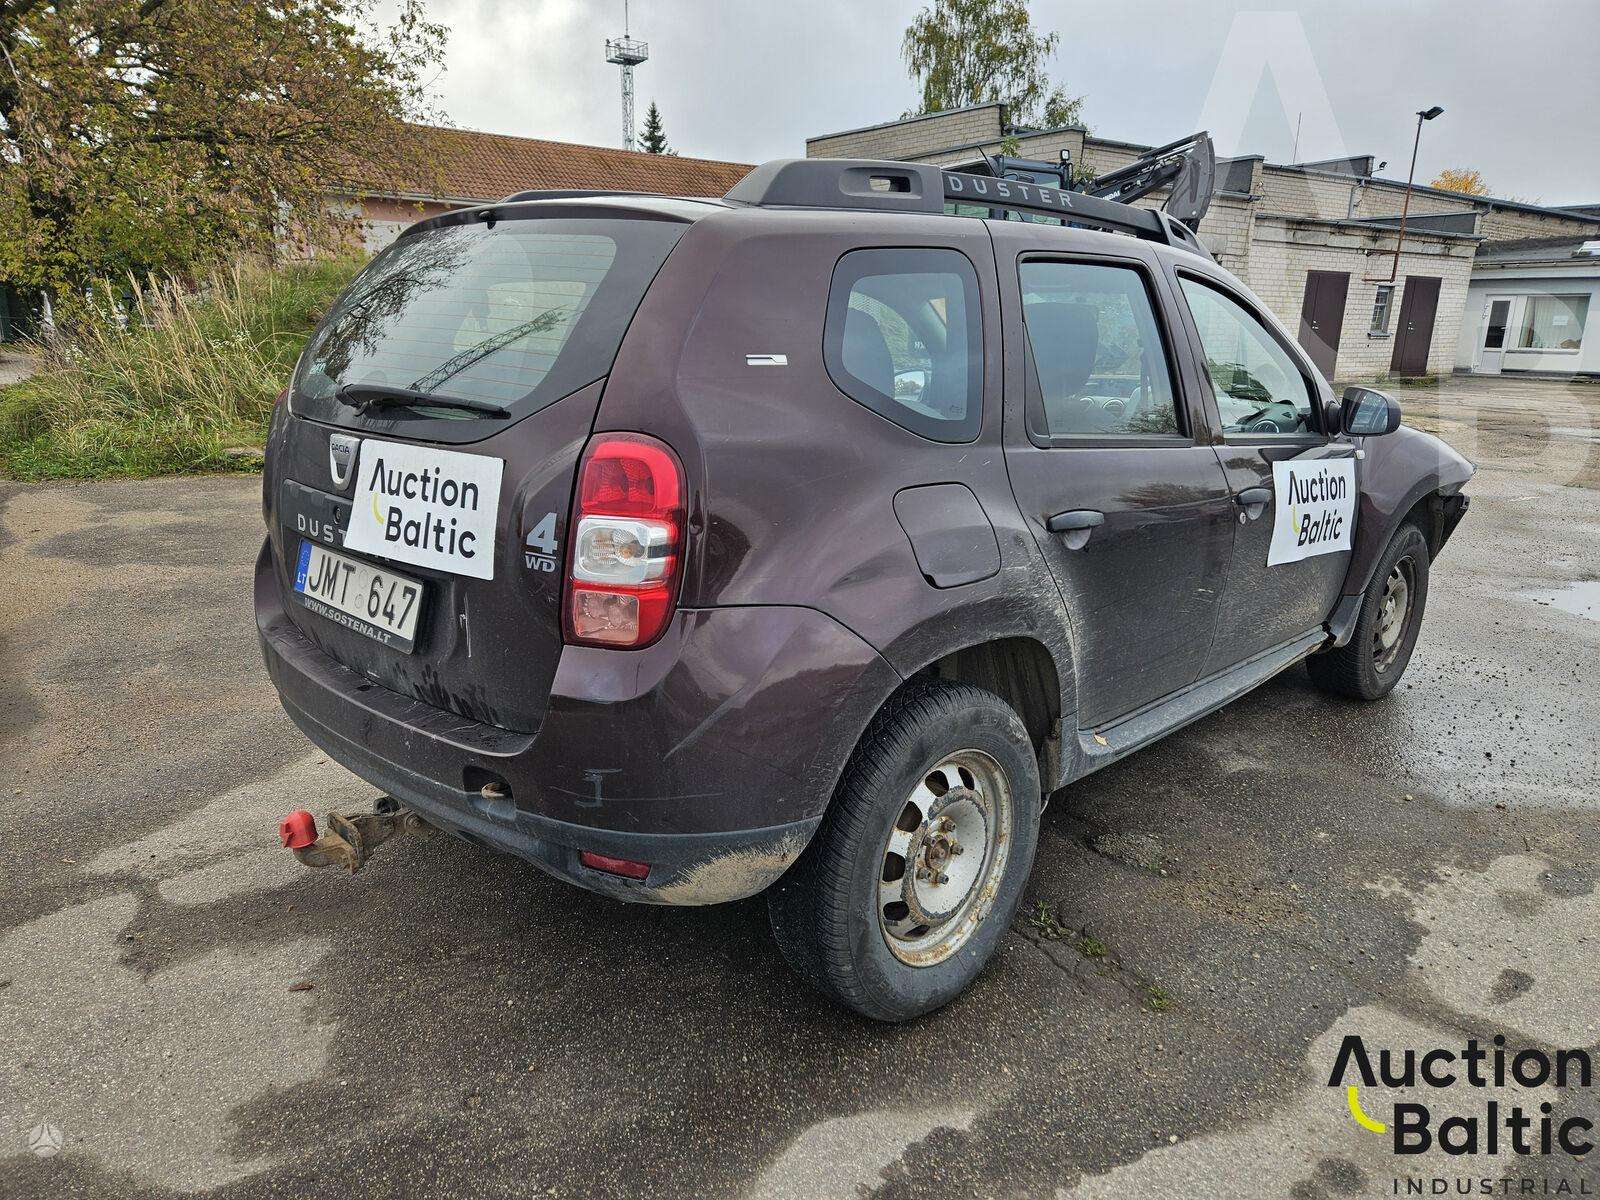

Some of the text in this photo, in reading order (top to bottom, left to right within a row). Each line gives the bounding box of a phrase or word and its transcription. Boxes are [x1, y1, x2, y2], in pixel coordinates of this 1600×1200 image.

[947, 175, 1073, 208] DUSTER
[331, 443, 351, 455] DACIA
[369, 458, 479, 511] Auction
[1288, 468, 1346, 506] Auction
[297, 513, 348, 543] DUST
[385, 506, 476, 559] Baltic
[526, 512, 559, 555] 4
[1297, 510, 1343, 547] Baltic
[525, 555, 556, 573] WD
[308, 554, 418, 630] JMT 647
[303, 597, 392, 643] WWW.SOSTENA.LT
